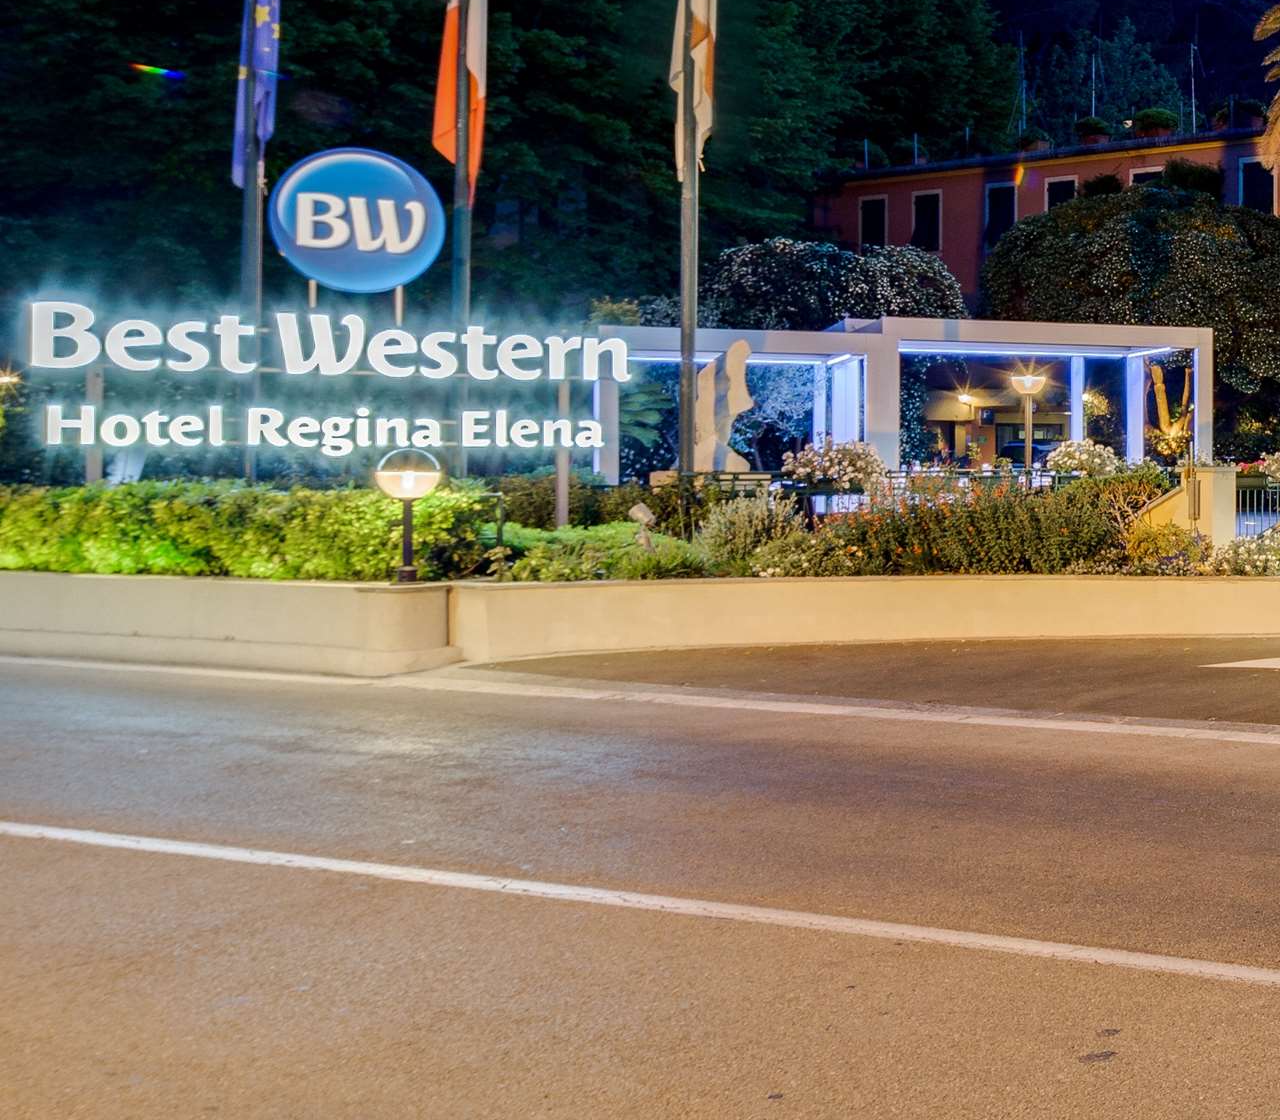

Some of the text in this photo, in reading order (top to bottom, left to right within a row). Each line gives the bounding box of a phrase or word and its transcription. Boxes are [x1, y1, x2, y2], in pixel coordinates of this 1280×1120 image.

[295, 192, 427, 255] BW
[28, 300, 632, 382] Best Western
[46, 404, 605, 457] Hotel Regina Elena
